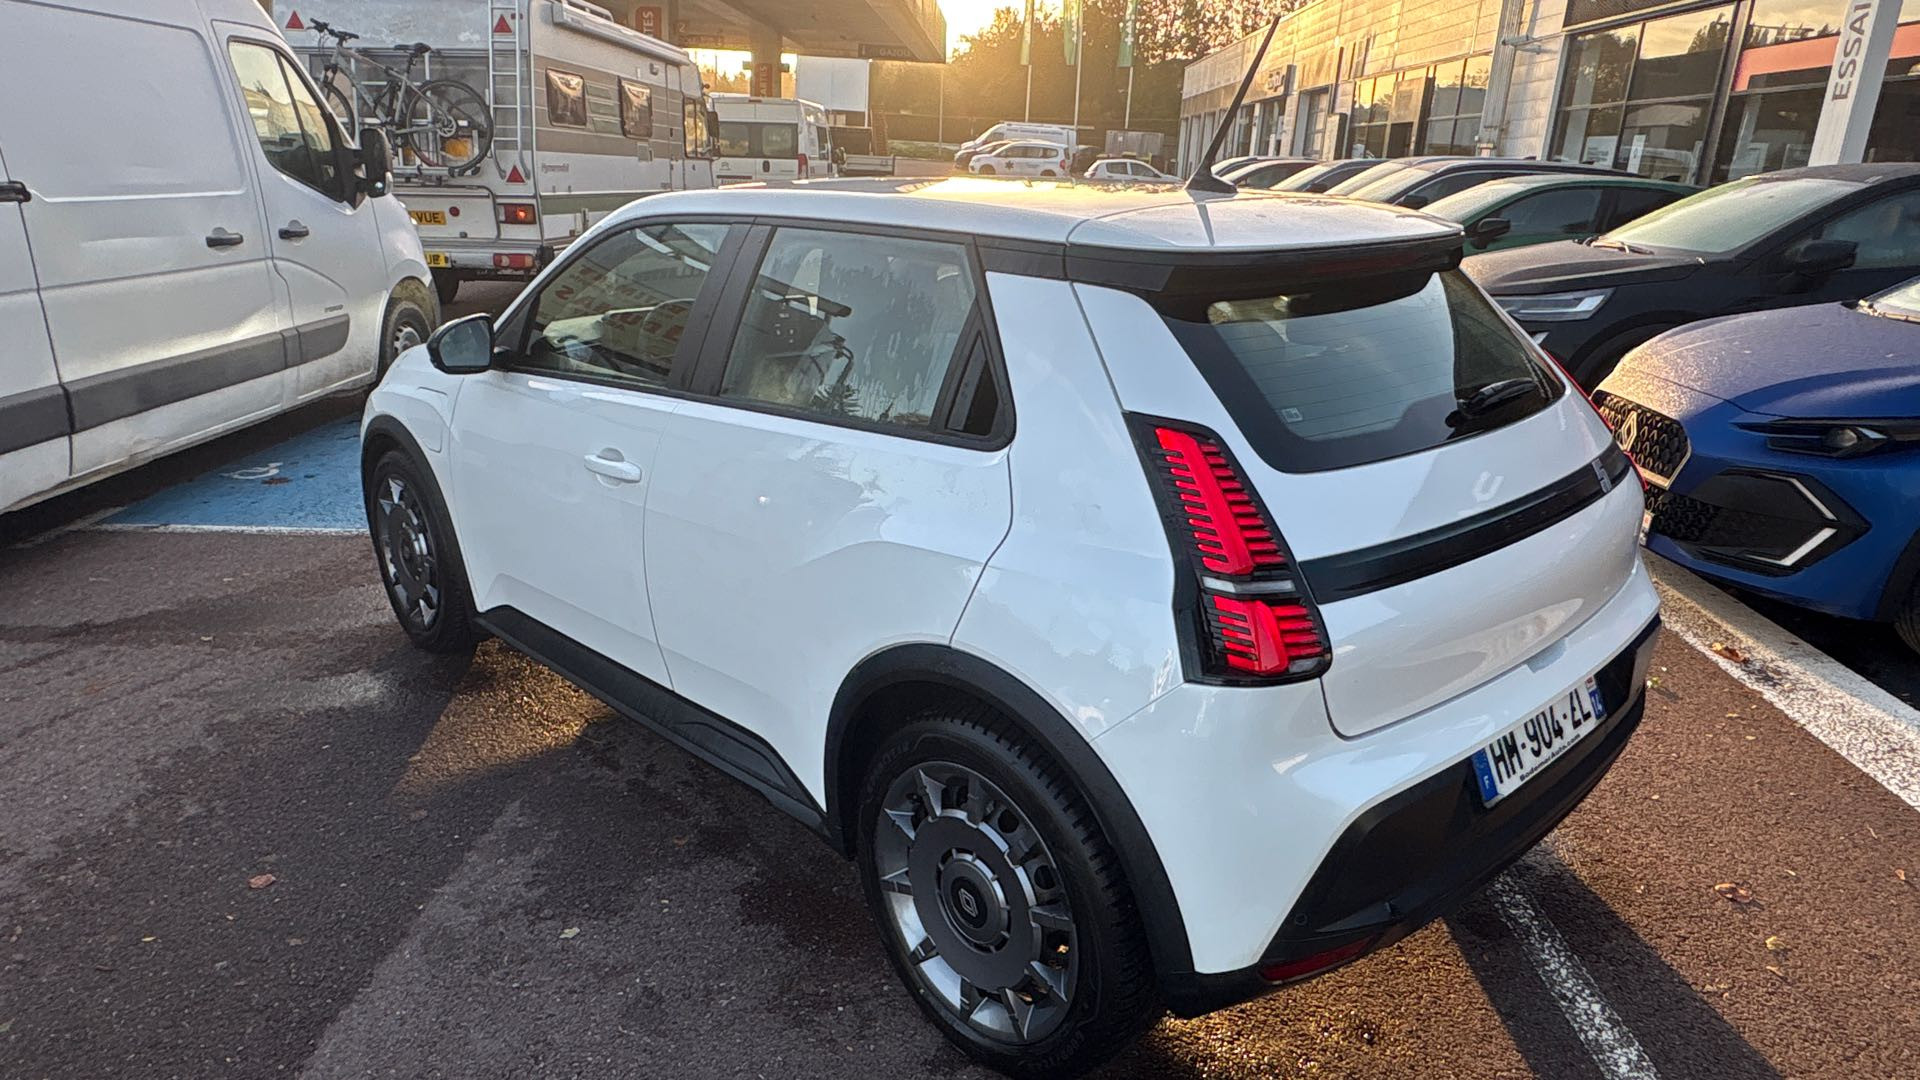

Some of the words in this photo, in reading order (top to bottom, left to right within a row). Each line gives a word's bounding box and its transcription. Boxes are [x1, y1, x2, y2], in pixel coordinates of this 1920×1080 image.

[642, 10, 654, 37] TES
[879, 47, 911, 57] GAZOL
[1832, 3, 1871, 101] ESSAI
[415, 211, 441, 223] VUE
[1483, 774, 1490, 790] F
